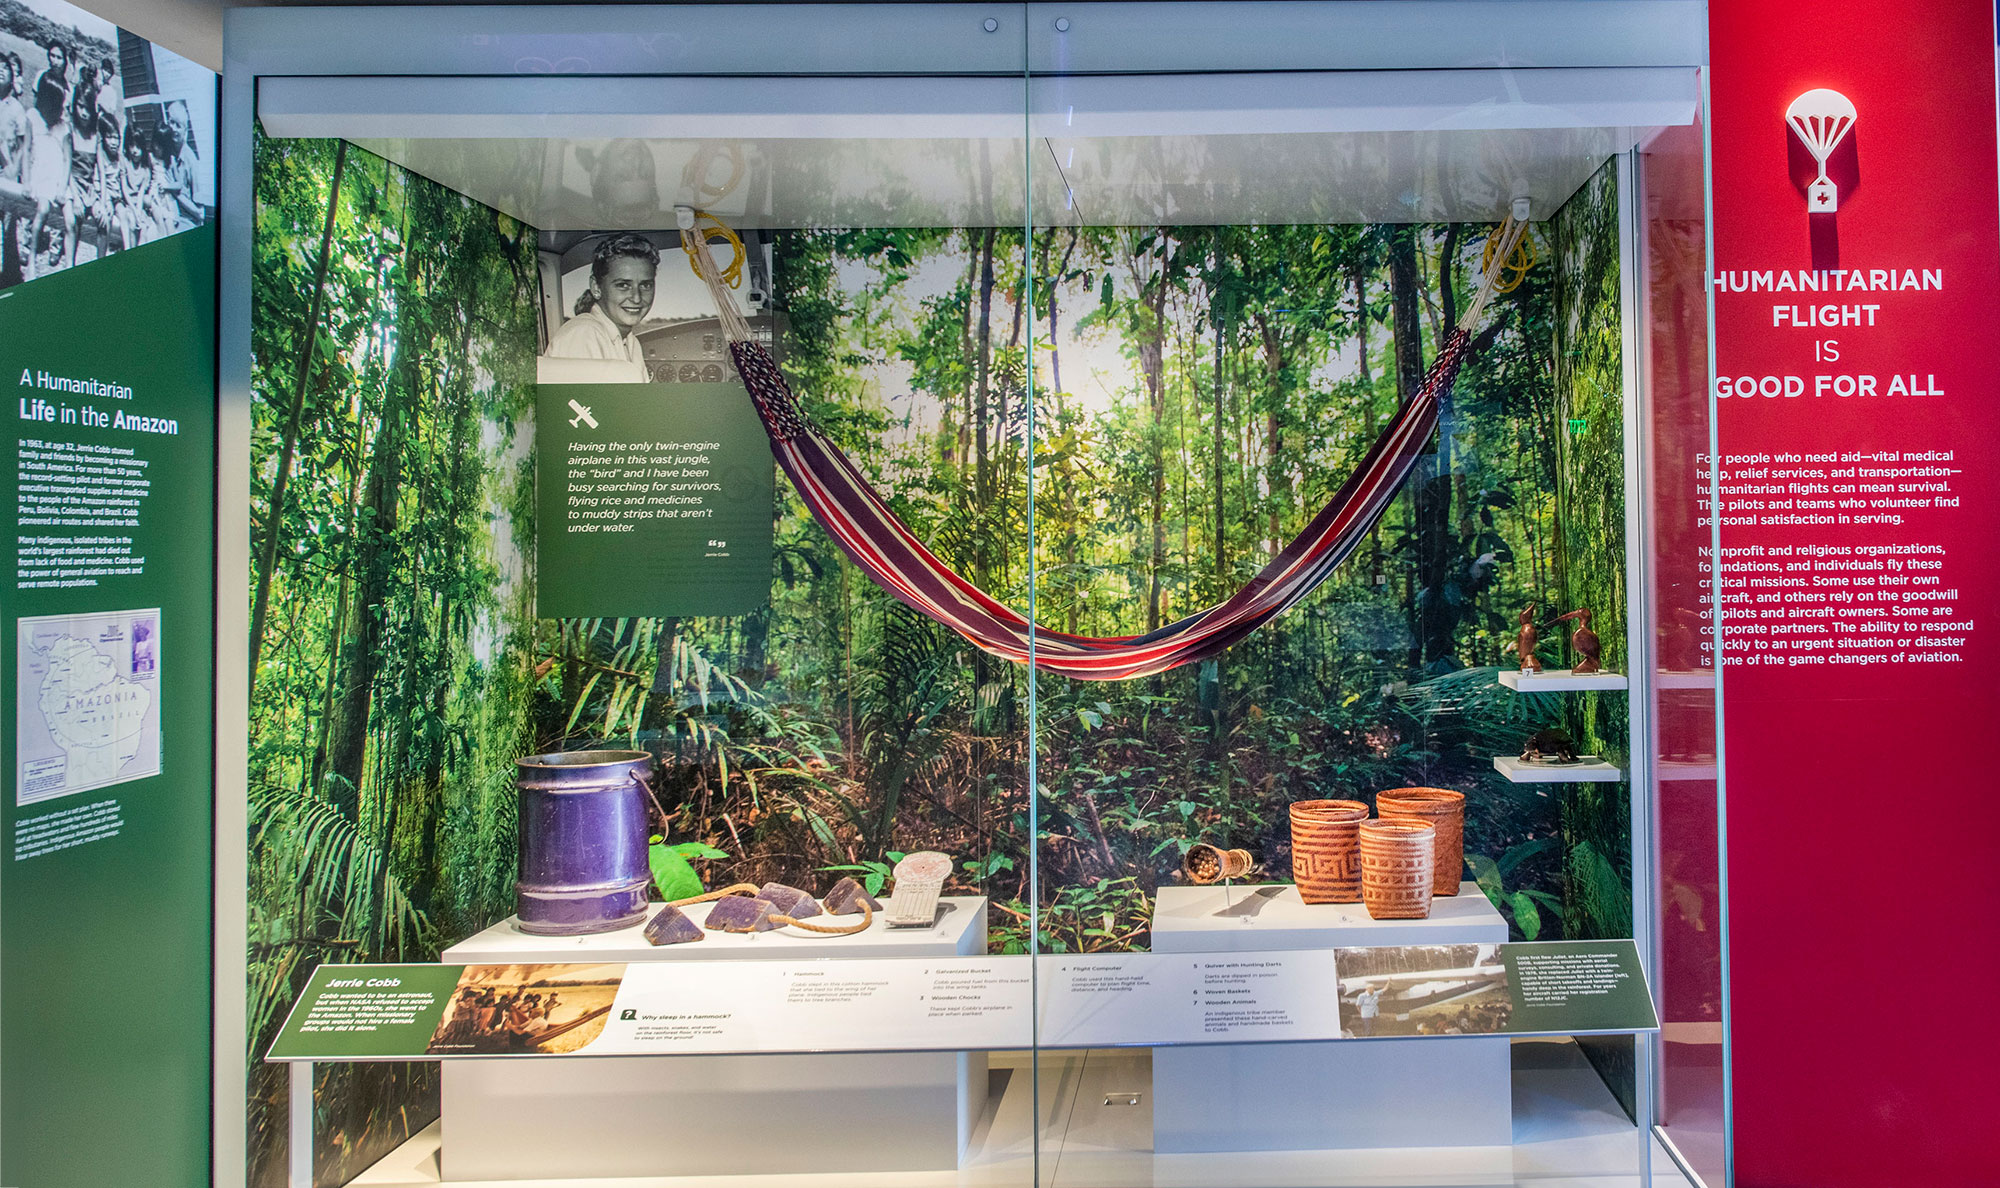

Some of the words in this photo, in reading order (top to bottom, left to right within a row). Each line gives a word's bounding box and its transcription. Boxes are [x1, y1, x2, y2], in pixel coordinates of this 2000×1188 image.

[1704, 268, 1943, 292] HUMANITARIAN
[1772, 304, 1880, 327] FLIGHT
[1815, 339, 1839, 362] IS
[19, 368, 32, 386] A
[37, 370, 132, 400] Humanitarian
[1716, 375, 1804, 398] GOOD
[1814, 374, 1877, 397] FOR
[1886, 374, 1944, 396] ALL
[20, 398, 55, 422] Life
[61, 402, 76, 425] in
[80, 405, 108, 428] the
[112, 409, 177, 435] Amazon
[18, 438, 25, 446] In
[26, 439, 44, 449] 1963,
[43, 441, 52, 449] at
[52, 442, 64, 451] age
[65, 442, 76, 452] 32,
[75, 443, 94, 452] Jerrie
[93, 445, 110, 454] Cobb
[110, 447, 133, 456] stunned
[567, 441, 606, 453] Having
[608, 441, 627, 451] the
[628, 441, 653, 452] only
[655, 440, 720, 451] twin-engine
[18, 449, 39, 460] family
[39, 451, 52, 460] and
[52, 451, 75, 461] friends
[75, 453, 84, 463] by
[84, 454, 114, 465] becoming
[118, 457, 148, 468] missionary
[567, 455, 612, 466] airplane
[613, 455, 624, 464] in
[627, 454, 647, 464] this
[649, 455, 672, 464] vast
[673, 454, 710, 465] jungle,
[1696, 452, 1722, 464] For
[1725, 452, 1770, 465] people
[1773, 451, 1801, 462] who
[1805, 451, 1837, 462] need
[1840, 450, 1899, 462] aid—vital
[1903, 449, 1953, 461] medical
[568, 468, 586, 478] the
[589, 468, 622, 478] “bird”
[622, 468, 645, 478] and
[646, 468, 651, 477] I
[652, 468, 679, 477] have
[681, 467, 709, 477] been
[1696, 468, 1731, 481] hep,
[1735, 467, 1768, 479] relief
[1771, 467, 1827, 479] services,
[1830, 466, 1855, 477] and
[1858, 465, 1962, 479] transportation—
[567, 482, 595, 493] busy
[596, 481, 649, 493] searching
[651, 481, 668, 491] for
[670, 481, 721, 491] survivors,
[1787, 482, 1829, 495] flights
[1832, 484, 1855, 493] can
[1859, 483, 1894, 493] mean
[1897, 480, 1951, 492] survival.
[567, 495, 599, 507] flying
[600, 495, 622, 505] rice
[623, 495, 646, 505] and
[647, 494, 703, 504] medicines
[1696, 499, 1725, 511] The
[1728, 498, 1765, 511] pilots
[1767, 498, 1792, 509] and
[1795, 498, 1835, 509] teams
[1838, 497, 1866, 508] who
[1869, 496, 1931, 508] volunteer
[1934, 495, 1959, 507] find
[567, 510, 580, 519] to
[581, 509, 621, 520] muddy
[622, 508, 653, 519] strips
[656, 508, 679, 518] that
[680, 508, 713, 518] aren’t
[1760, 513, 1834, 525] satisfaction
[1838, 512, 1850, 524] in
[1853, 512, 1904, 525] serving.
[567, 522, 600, 532] under
[602, 523, 634, 532] water.
[1767, 544, 1792, 556] and
[1796, 544, 1851, 557] religious
[1854, 542, 1946, 556] organizations,
[1786, 559, 1810, 571] and
[1814, 558, 1884, 571] individuals
[1886, 558, 1903, 571] fly
[1906, 558, 1942, 569] these
[1750, 575, 1809, 587] missions.
[1812, 575, 1849, 586] Some
[1852, 576, 1875, 586] use
[1878, 574, 1909, 585] their
[1912, 575, 1939, 585] own
[1756, 591, 1781, 602] and
[1784, 591, 1826, 602] others
[1829, 590, 1854, 603] rely
[1857, 592, 1874, 601] on
[1877, 589, 1899, 601] the
[1901, 588, 1958, 602] goodwill
[64, 692, 137, 710] AMAZONIA
[325, 978, 364, 987] Jerrie
[365, 977, 401, 987] Cobb
